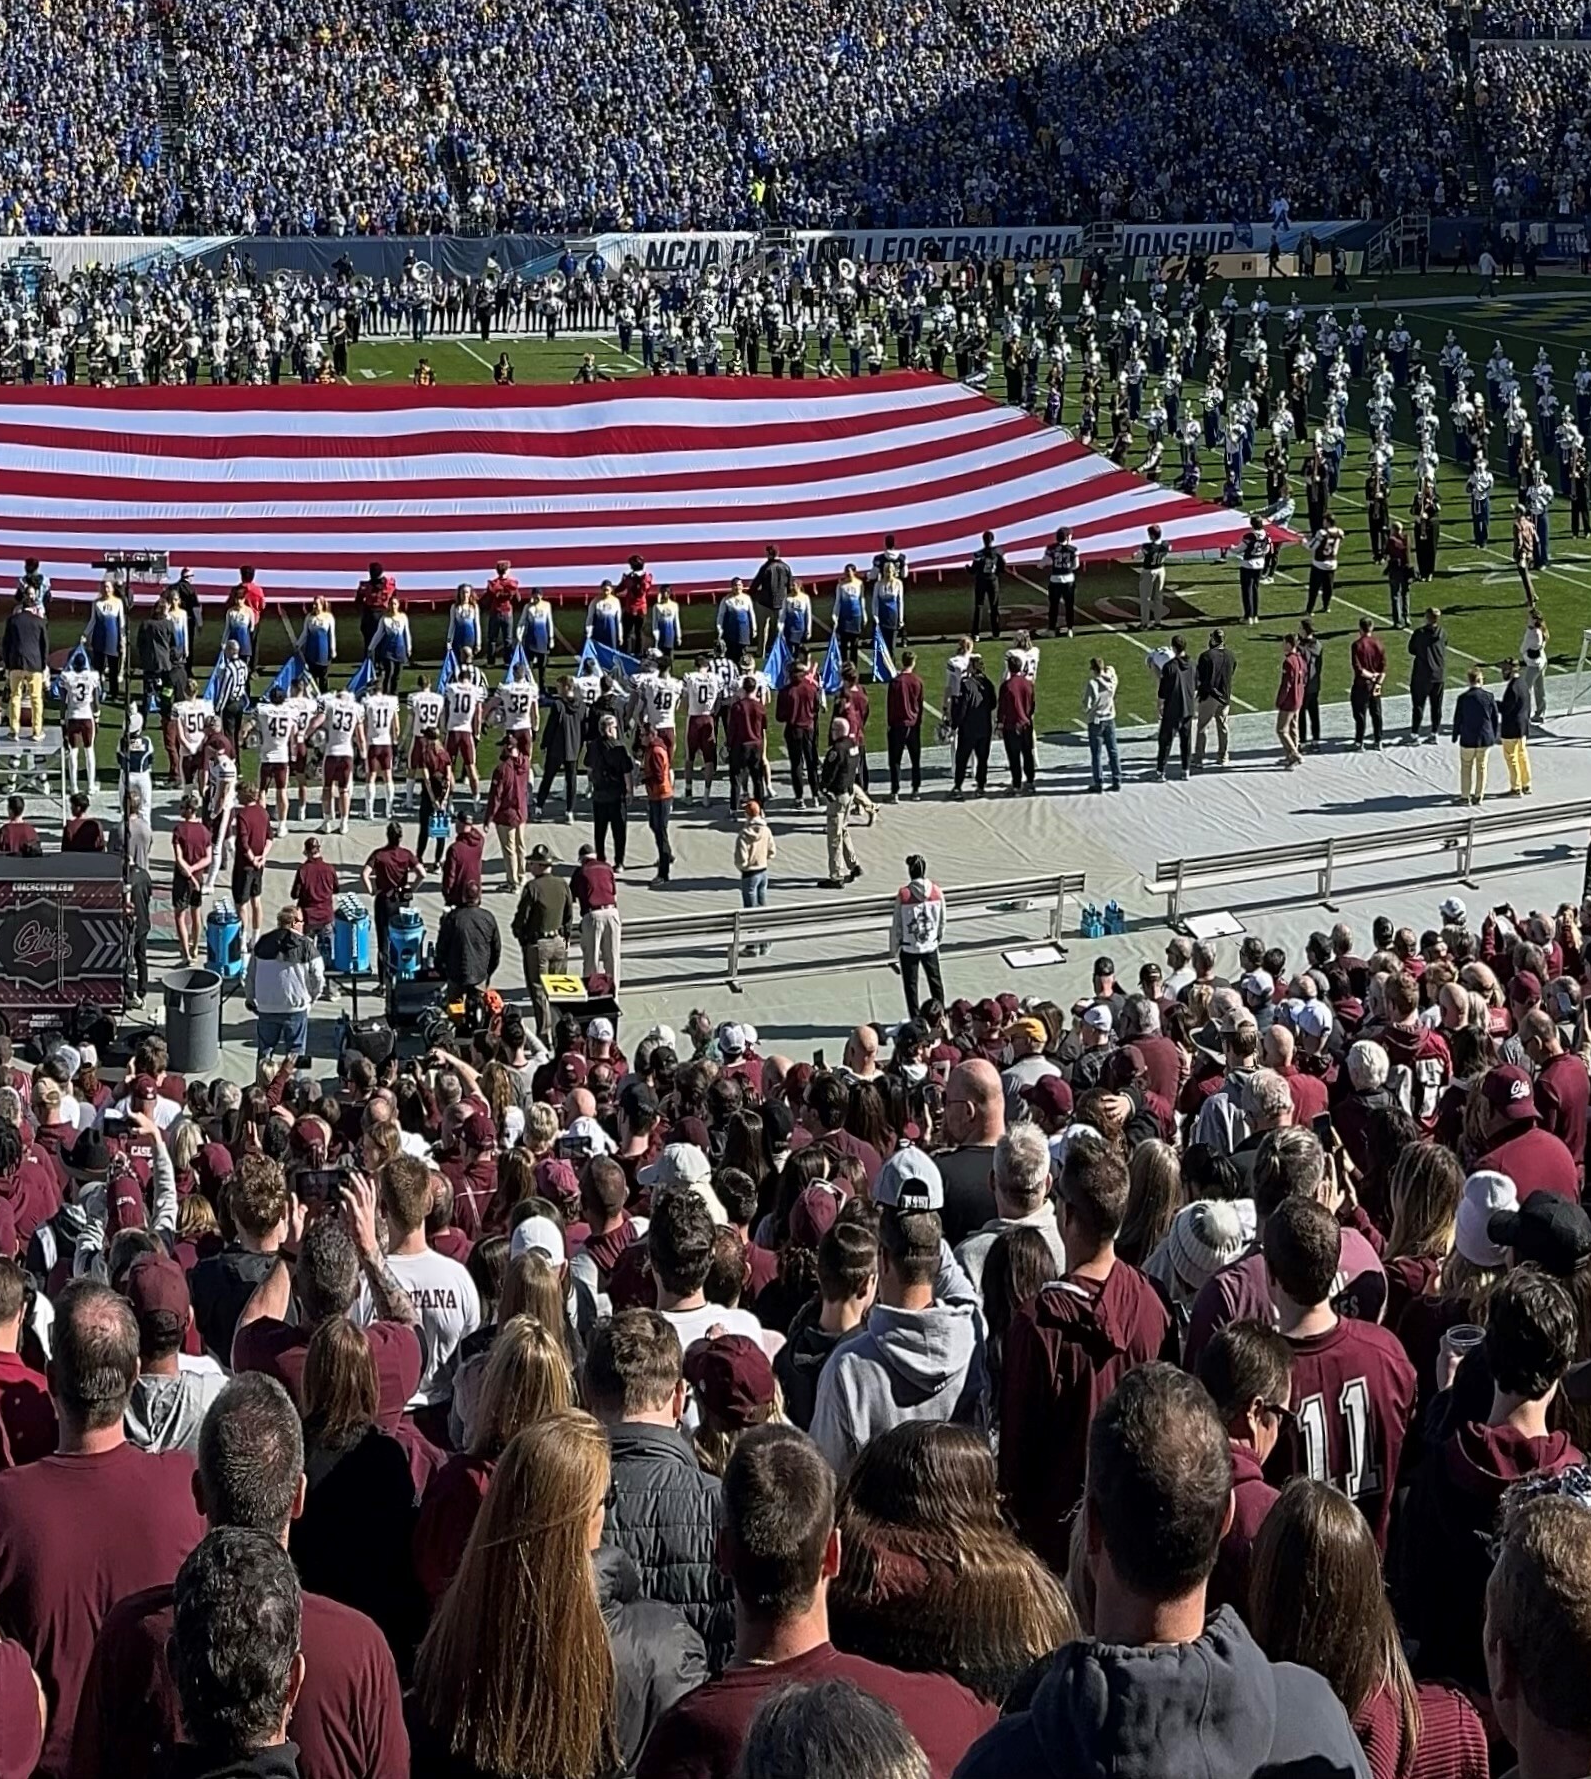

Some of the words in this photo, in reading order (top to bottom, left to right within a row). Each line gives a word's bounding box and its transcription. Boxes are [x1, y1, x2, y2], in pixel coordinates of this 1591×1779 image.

[646, 241, 721, 268] NCAA
[76, 683, 86, 702] 3
[698, 685, 708, 703] 0
[454, 694, 471, 713] 10
[508, 693, 529, 713] 32
[268, 717, 287, 736] 45
[333, 711, 352, 731] 33
[376, 708, 388, 726] 11
[419, 710, 438, 729] 39
[550, 978, 579, 993] 12
[131, 1147, 152, 1157] CASE
[1298, 1377, 1382, 1496] 11
